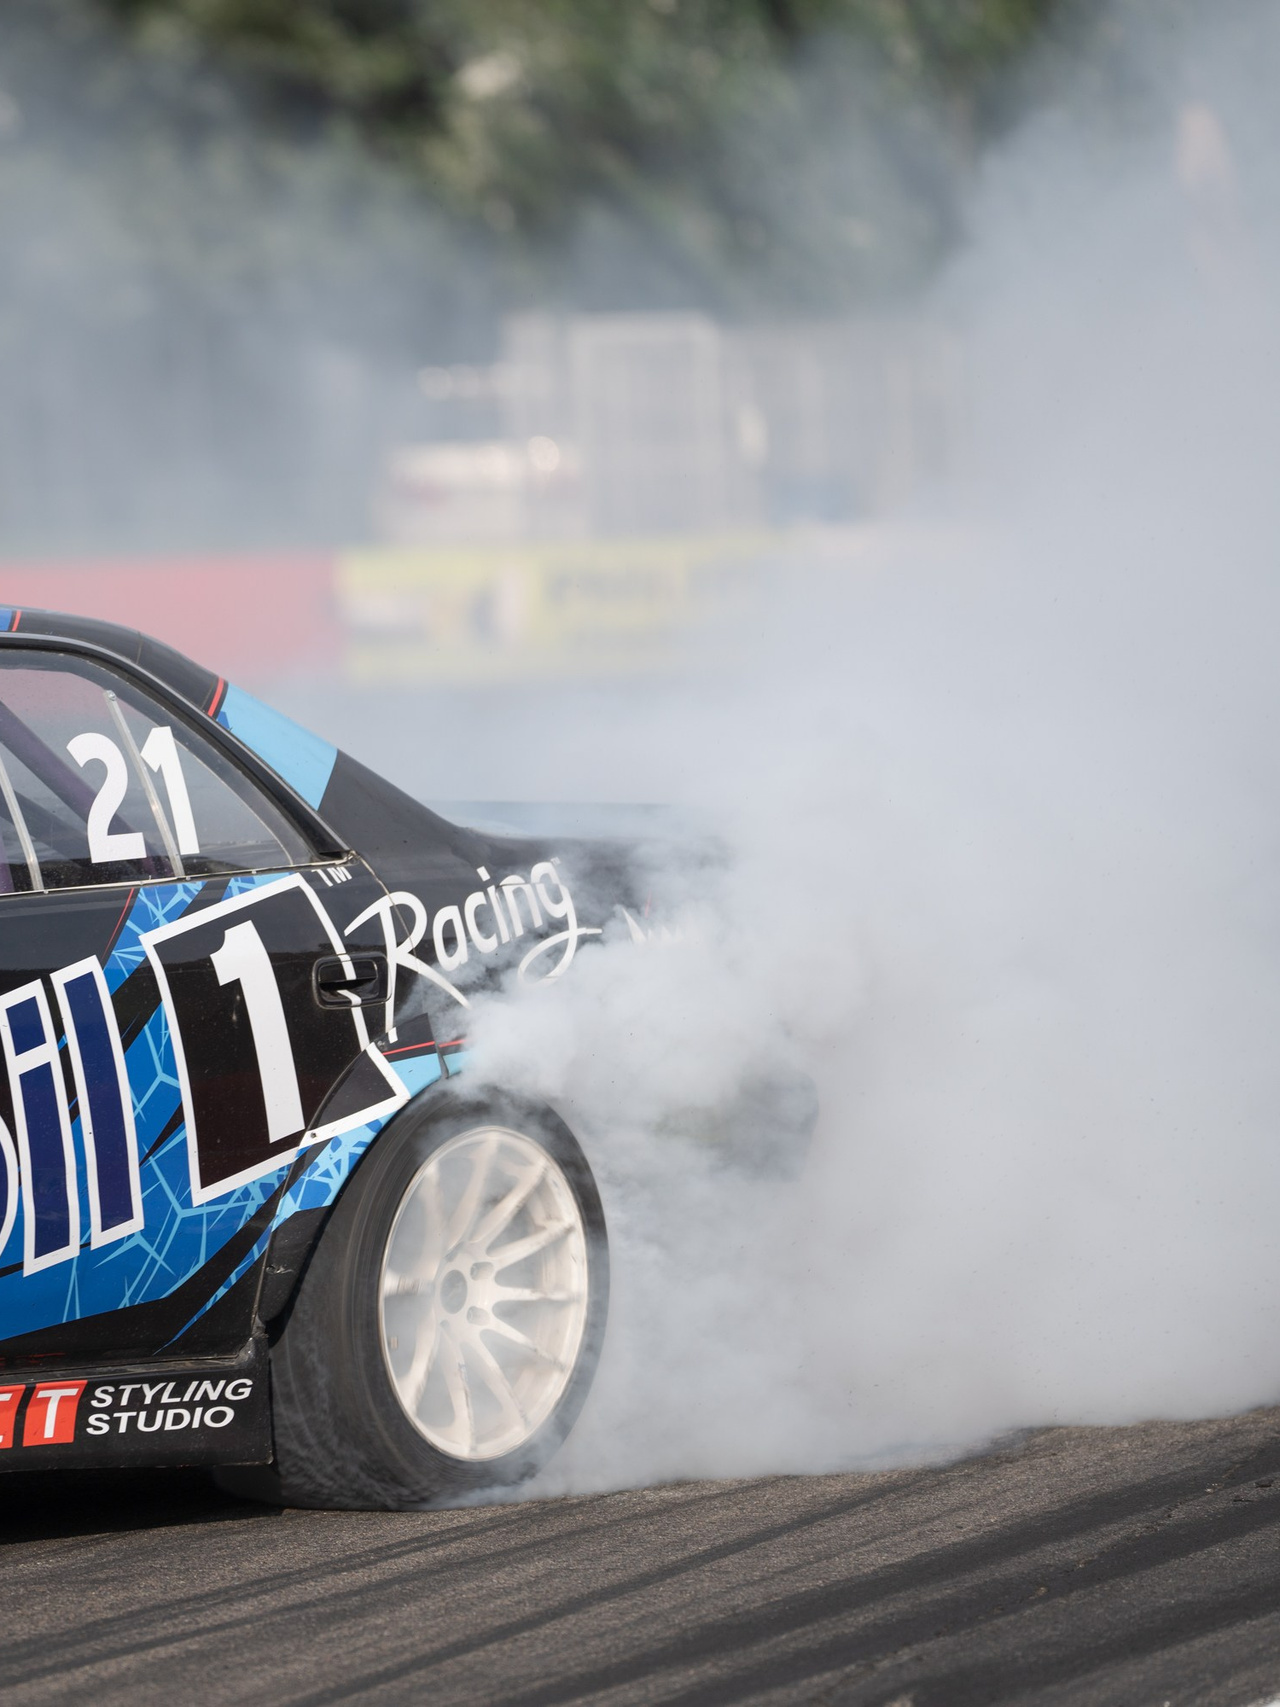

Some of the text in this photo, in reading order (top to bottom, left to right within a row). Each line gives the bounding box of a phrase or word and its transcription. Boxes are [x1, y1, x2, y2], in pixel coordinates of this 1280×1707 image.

[65, 726, 201, 864] 21
[344, 861, 603, 1043] Racing
[86, 1406, 235, 1436] STUDIO
[90, 1378, 254, 1409] STYLING
